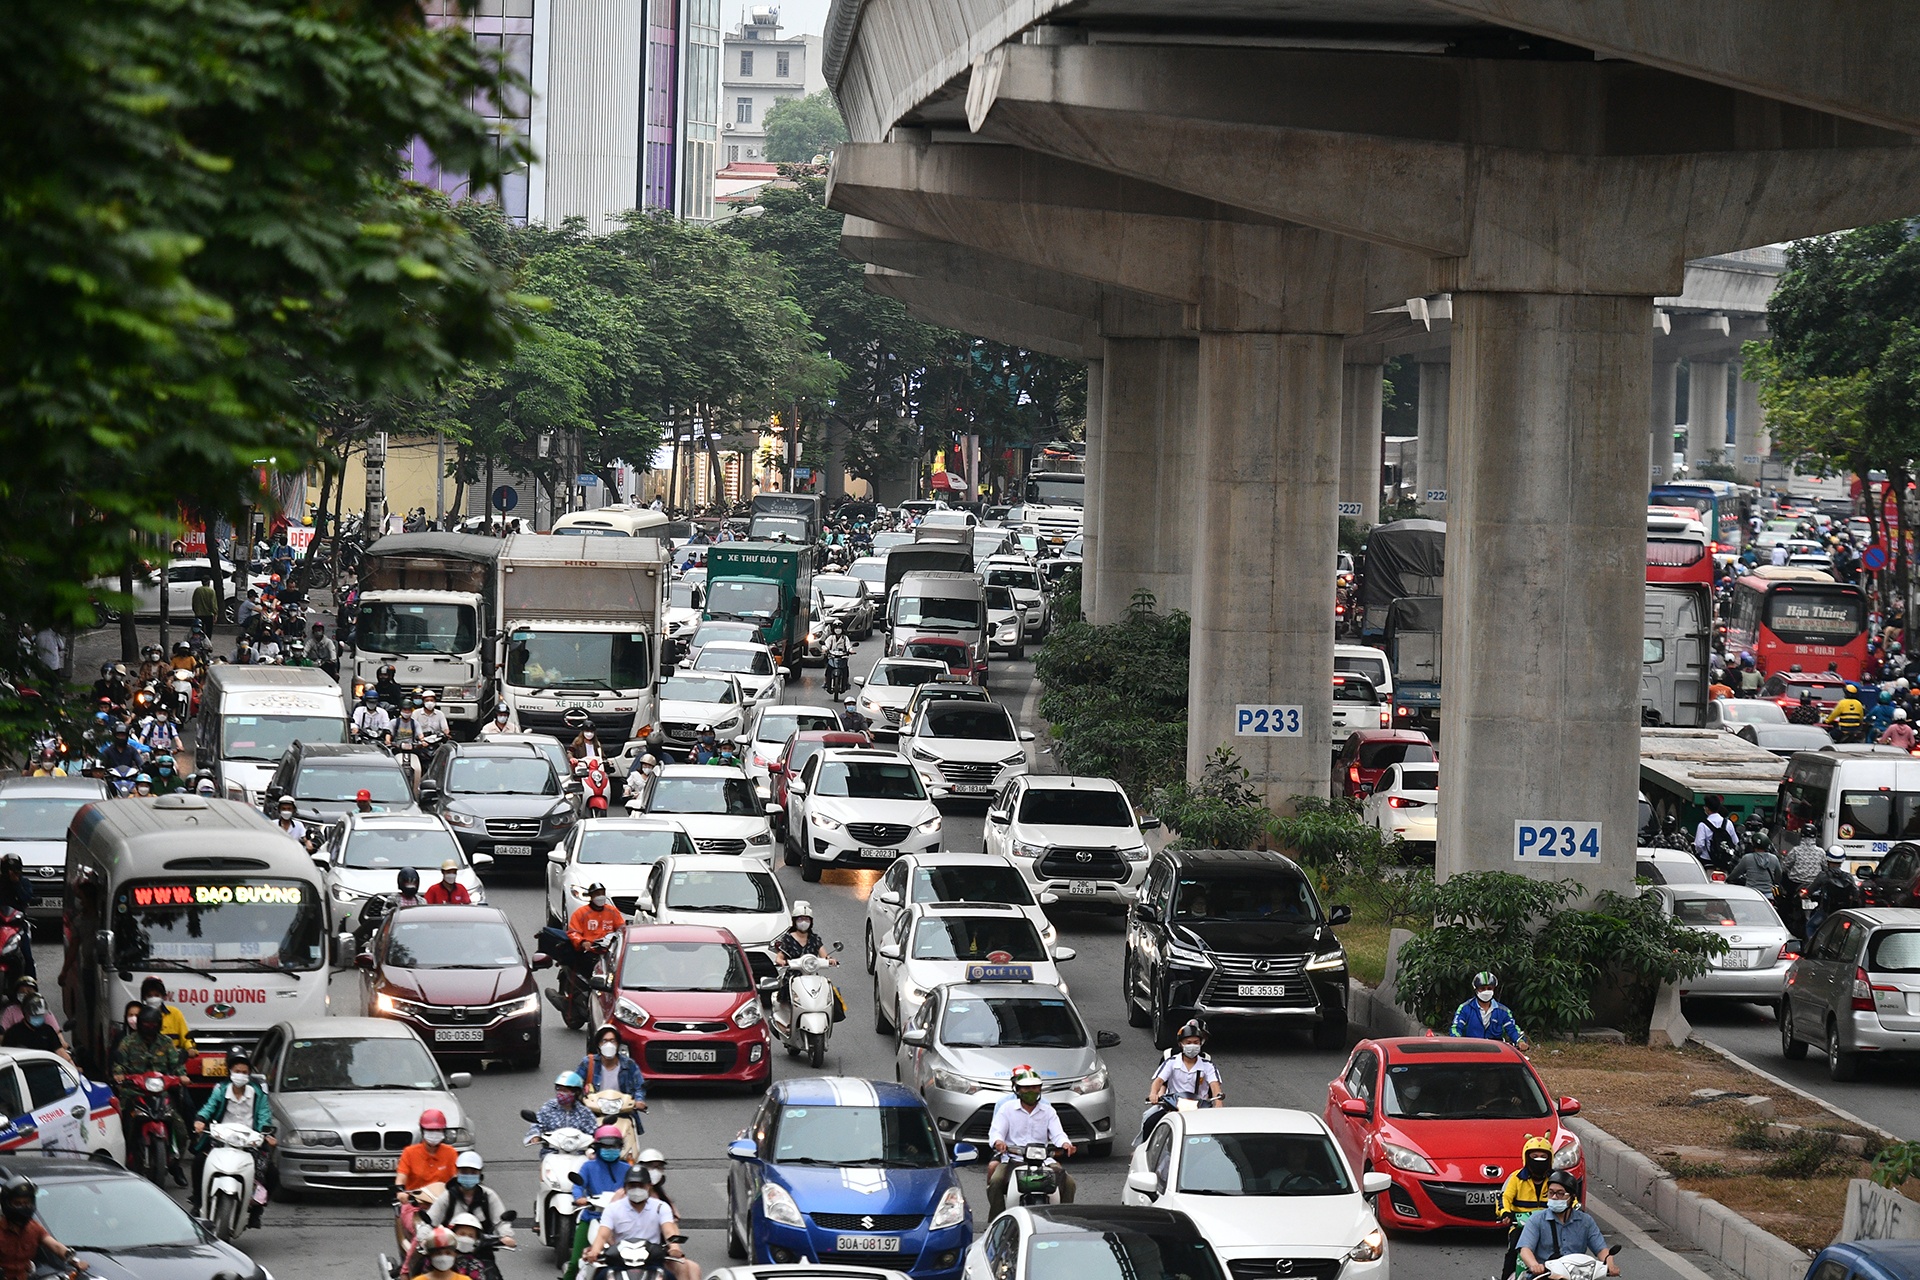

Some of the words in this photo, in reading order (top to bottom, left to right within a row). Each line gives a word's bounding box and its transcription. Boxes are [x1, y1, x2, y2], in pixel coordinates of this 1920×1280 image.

[741, 554, 759, 563] THƯ
[556, 700, 566, 708] XE
[1238, 709, 1299, 733] P233
[1519, 826, 1599, 857] P234
[134, 886, 193, 905] WWW.
[196, 886, 233, 905] ĐẠO
[235, 883, 302, 905] ĐƯỜNG
[1729, 950, 1742, 958] 29A
[178, 988, 209, 1006] ĐẠO
[214, 985, 266, 1003] ĐƯỜNG
[1240, 986, 1284, 996] 30E-353.53
[436, 1031, 483, 1040] 30G-036.59
[668, 1051, 714, 1061] 29D-104.61
[38, 1108, 66, 1124] TOSHIBA
[839, 1237, 897, 1250] 30A-081.97
